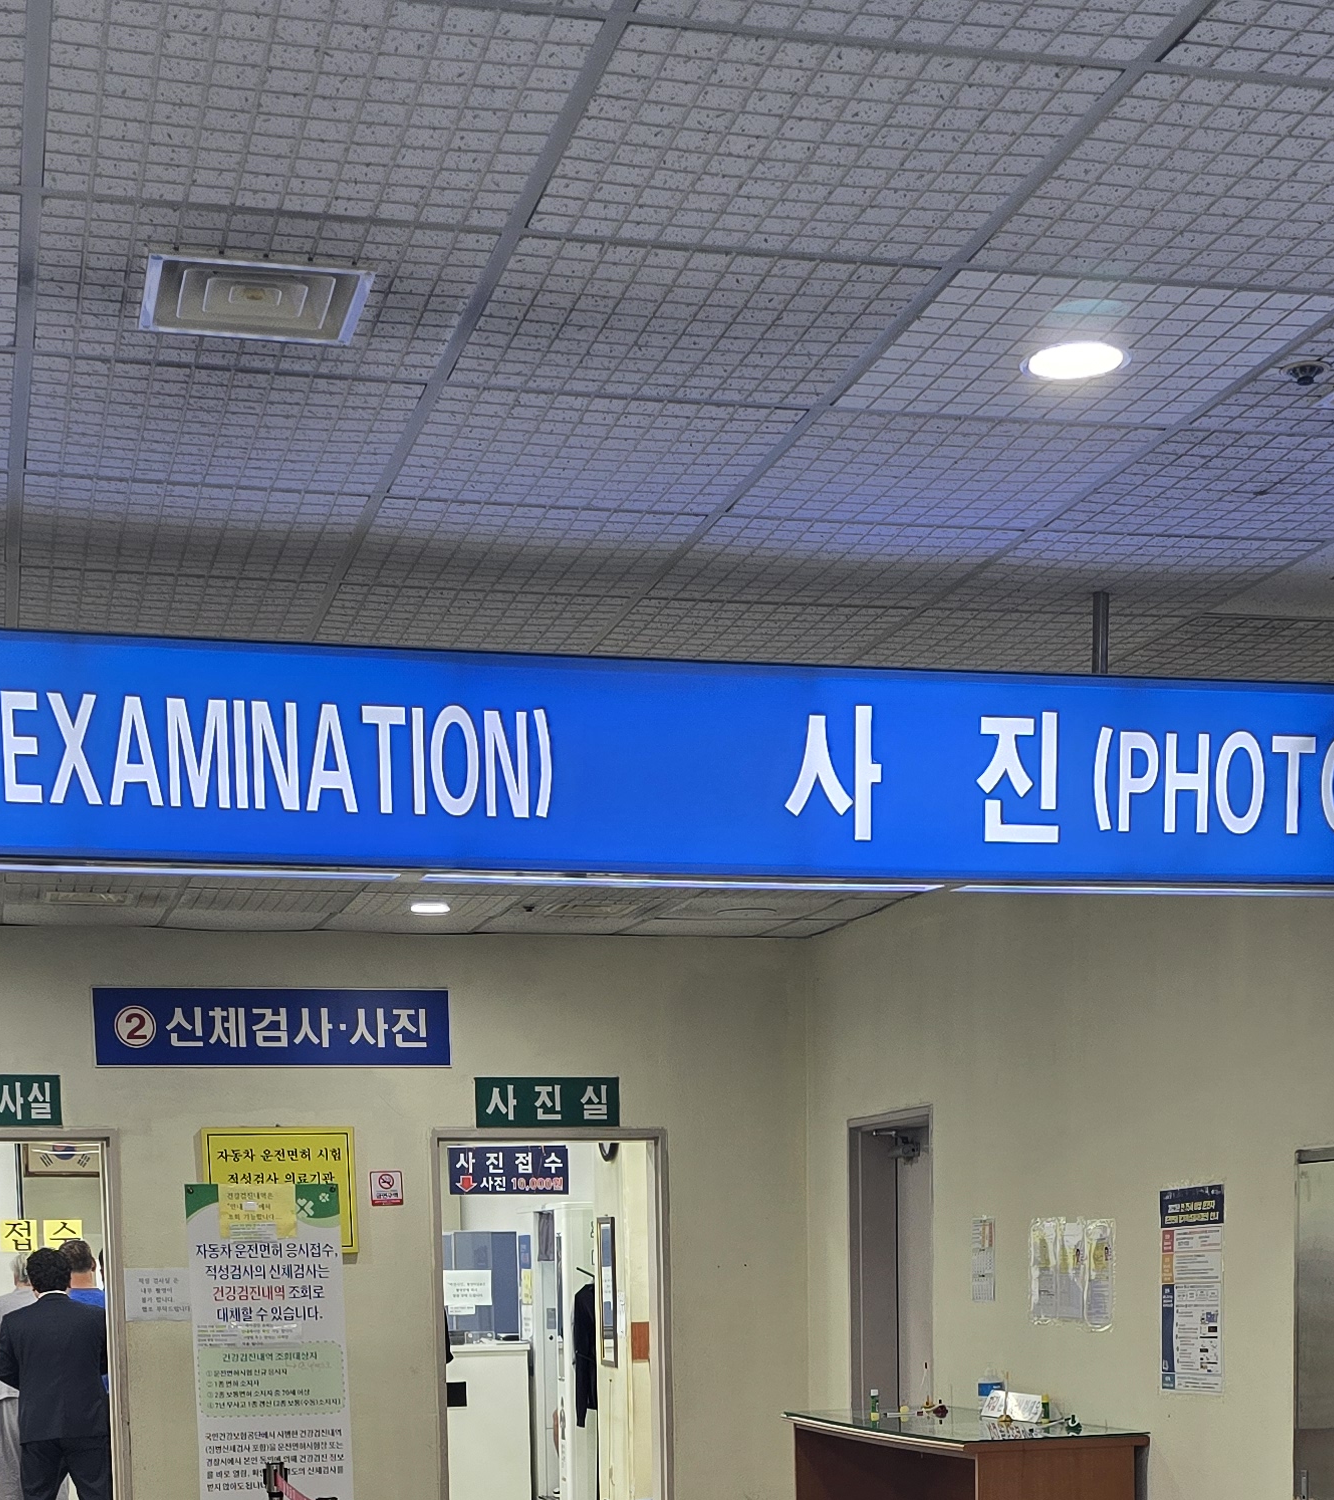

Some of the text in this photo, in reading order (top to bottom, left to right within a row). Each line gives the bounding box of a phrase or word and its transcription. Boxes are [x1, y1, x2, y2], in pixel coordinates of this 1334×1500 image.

[0, 690, 553, 818] EXAMINATION)
[165, 1006, 427, 1048] 신체검사·사진
[217, 1148, 341, 1162] 자동차 운전면허 시험
[228, 1172, 335, 1184] 적성검사 의료기관
[480, 1177, 563, 1191] 사진 10,000원
[196, 1243, 338, 1258] 자동차 운전면허 응시접수,
[205, 1264, 329, 1279] 적성검사의 신체검사는
[213, 1285, 325, 1301] 건강검진내역 조회로
[217, 1306, 323, 1322] 대체할 수 있습니다.
